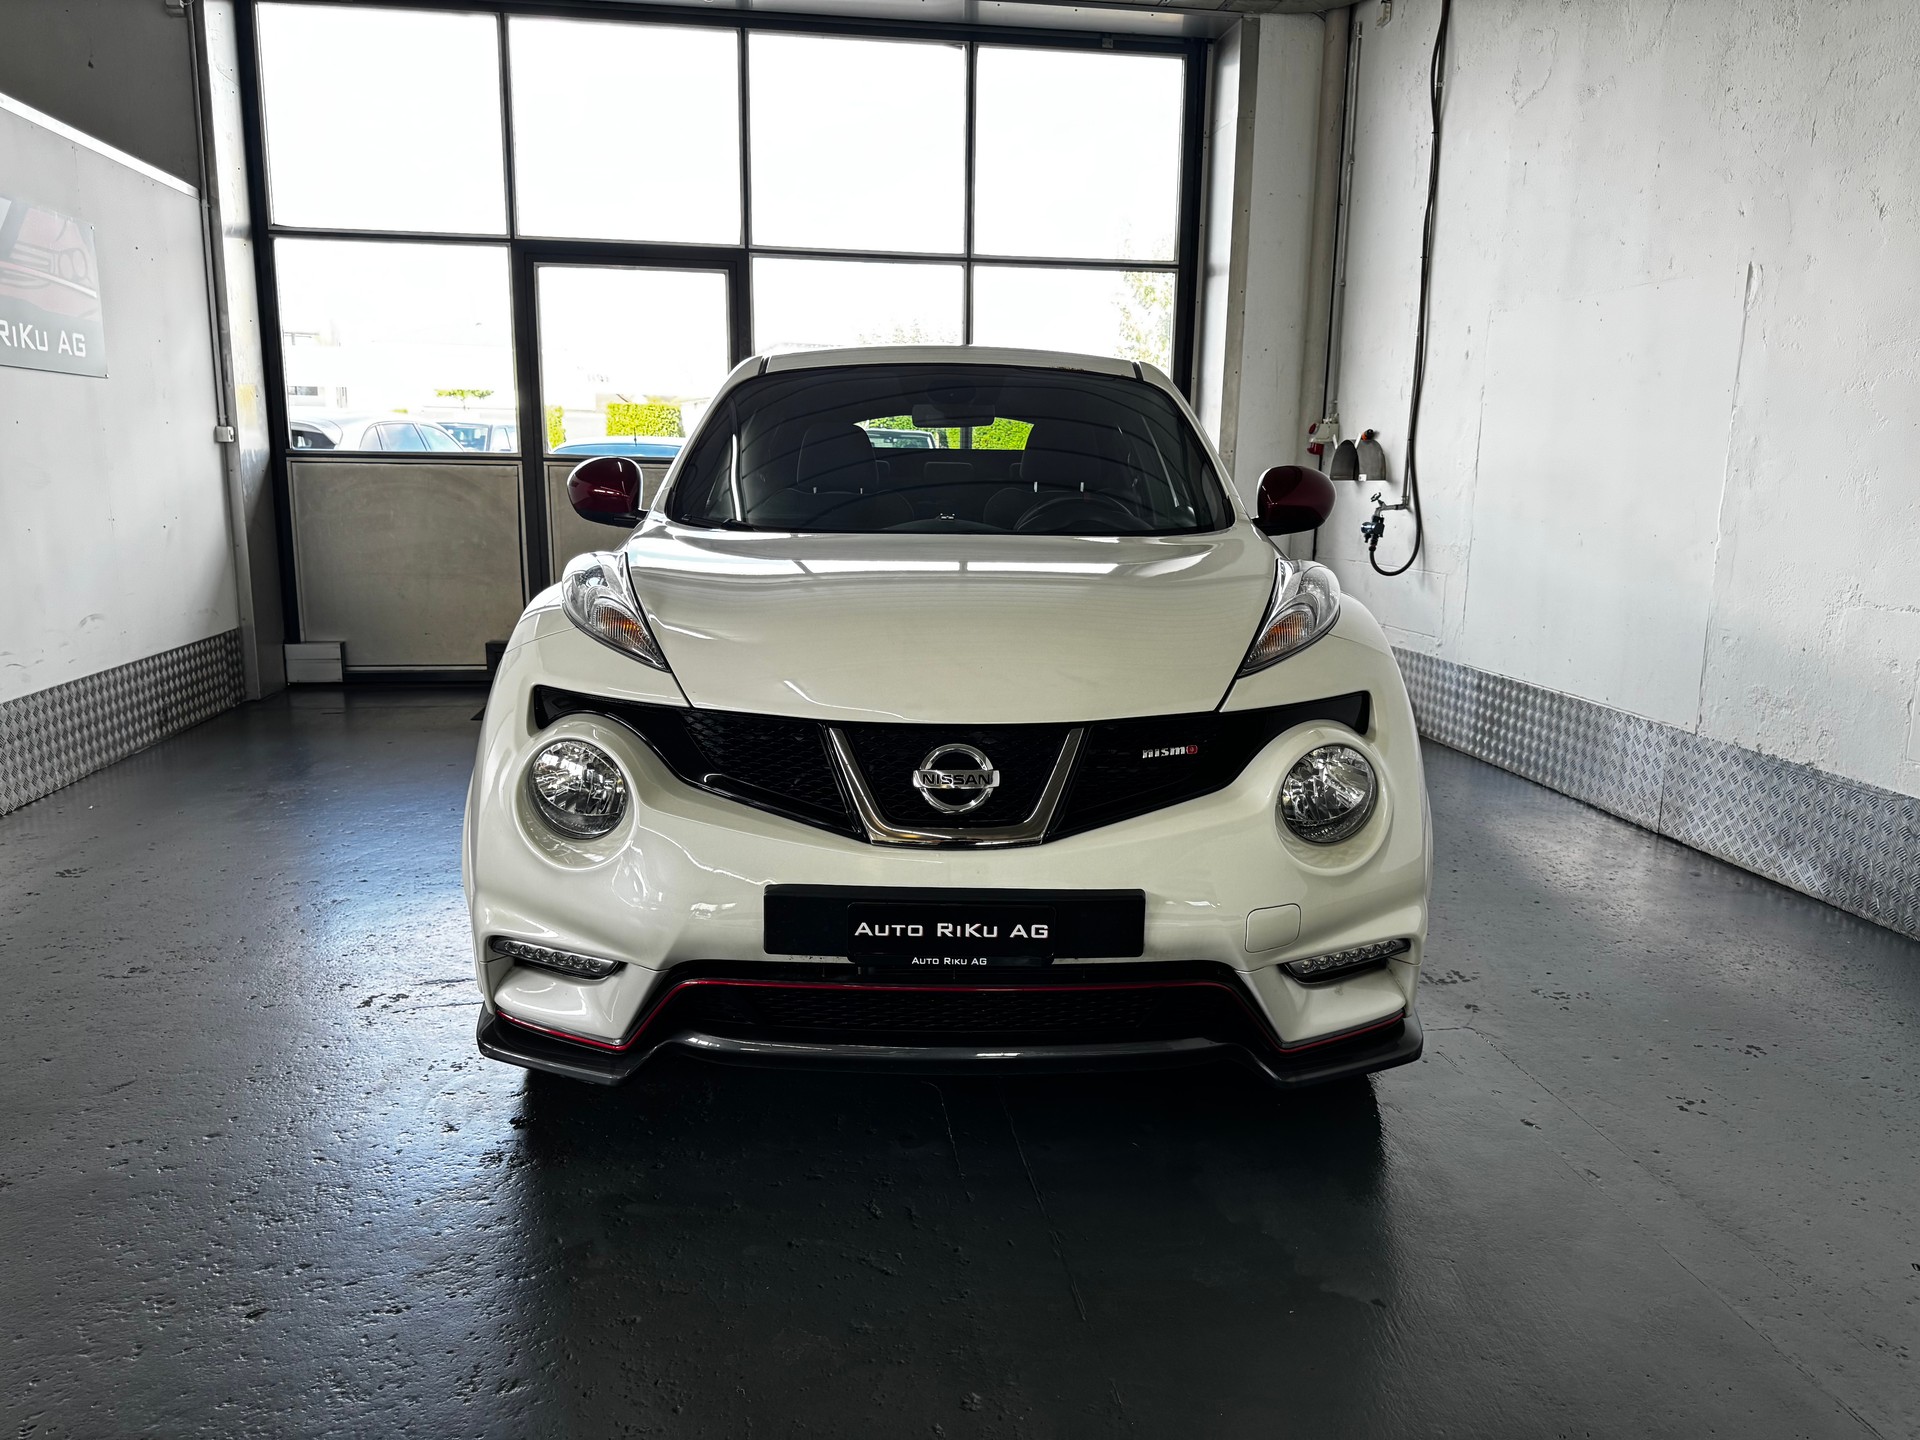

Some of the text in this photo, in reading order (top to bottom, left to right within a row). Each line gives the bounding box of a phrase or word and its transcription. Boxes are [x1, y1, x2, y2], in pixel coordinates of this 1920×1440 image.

[58, 330, 86, 357] AG
[922, 773, 991, 785] NISSAN
[1009, 924, 1049, 939] AG
[971, 957, 988, 966] AG
